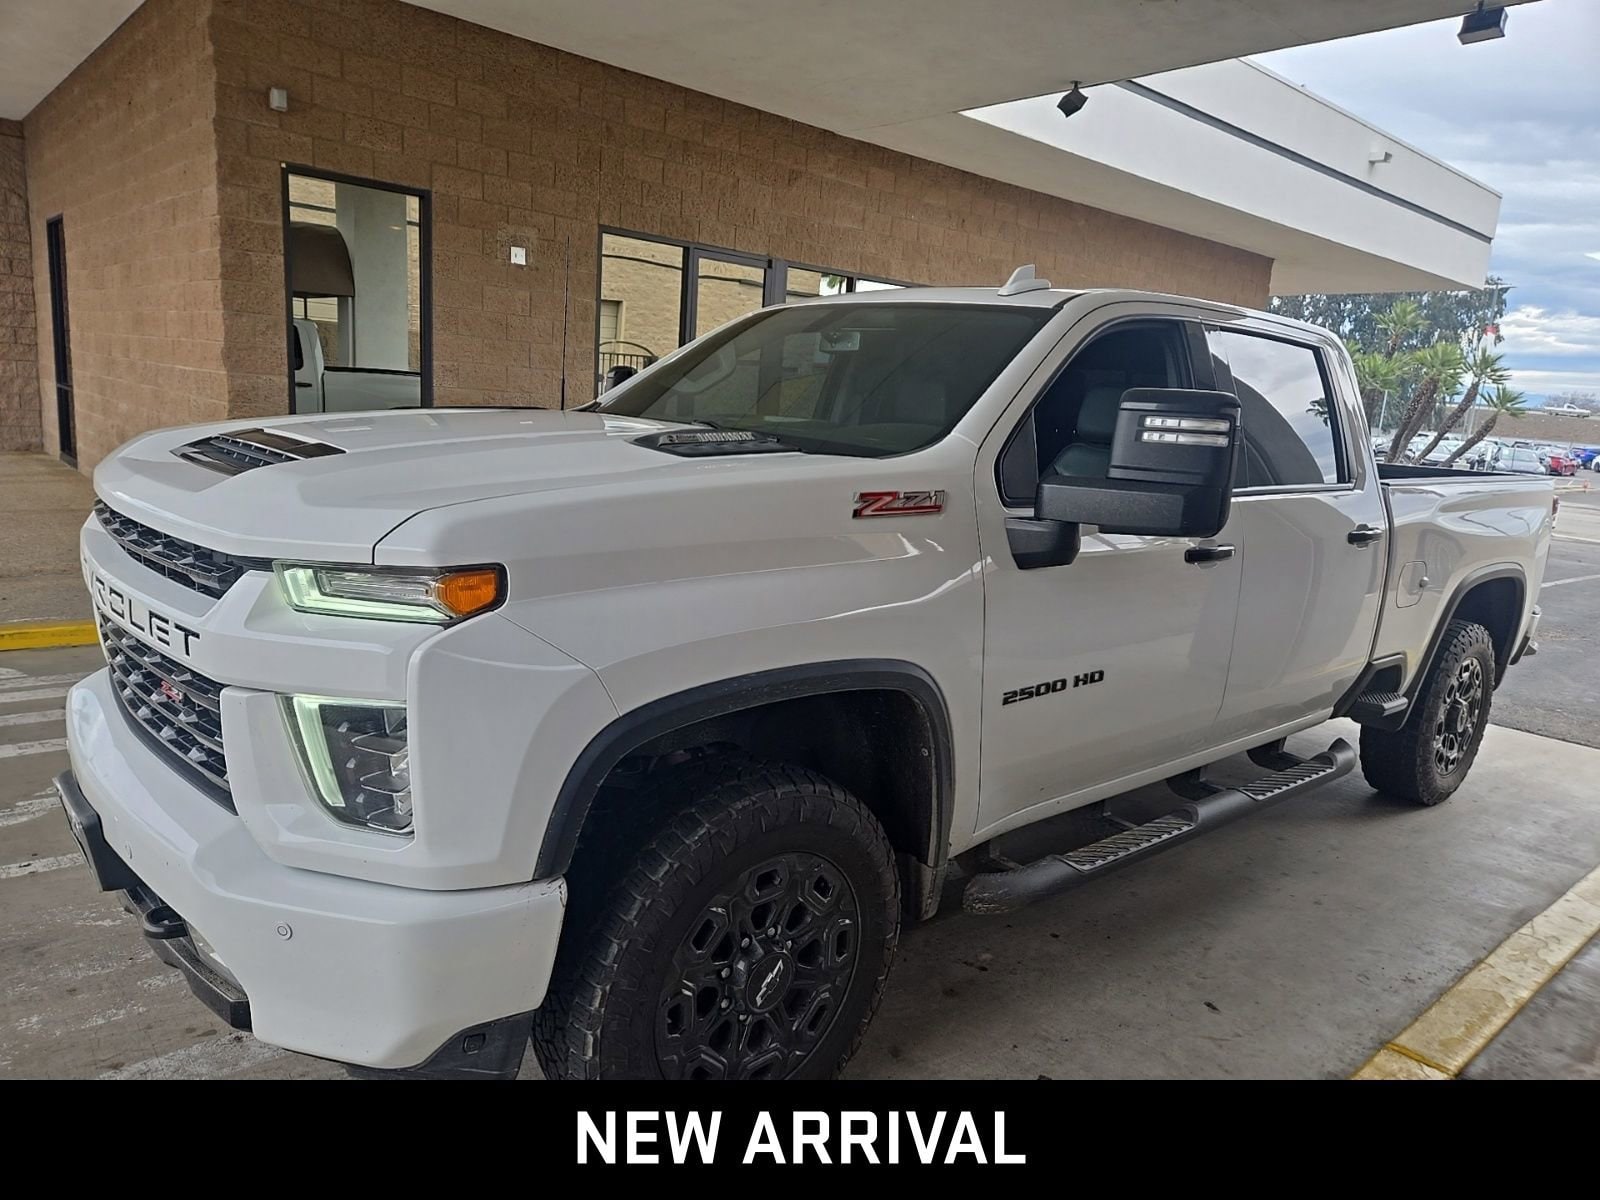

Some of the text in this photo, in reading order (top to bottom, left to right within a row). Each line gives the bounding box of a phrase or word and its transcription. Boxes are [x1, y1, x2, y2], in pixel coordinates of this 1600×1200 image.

[852, 490, 945, 518] Z71
[91, 572, 200, 656] ROLET
[1002, 670, 1104, 705] 2500 HD
